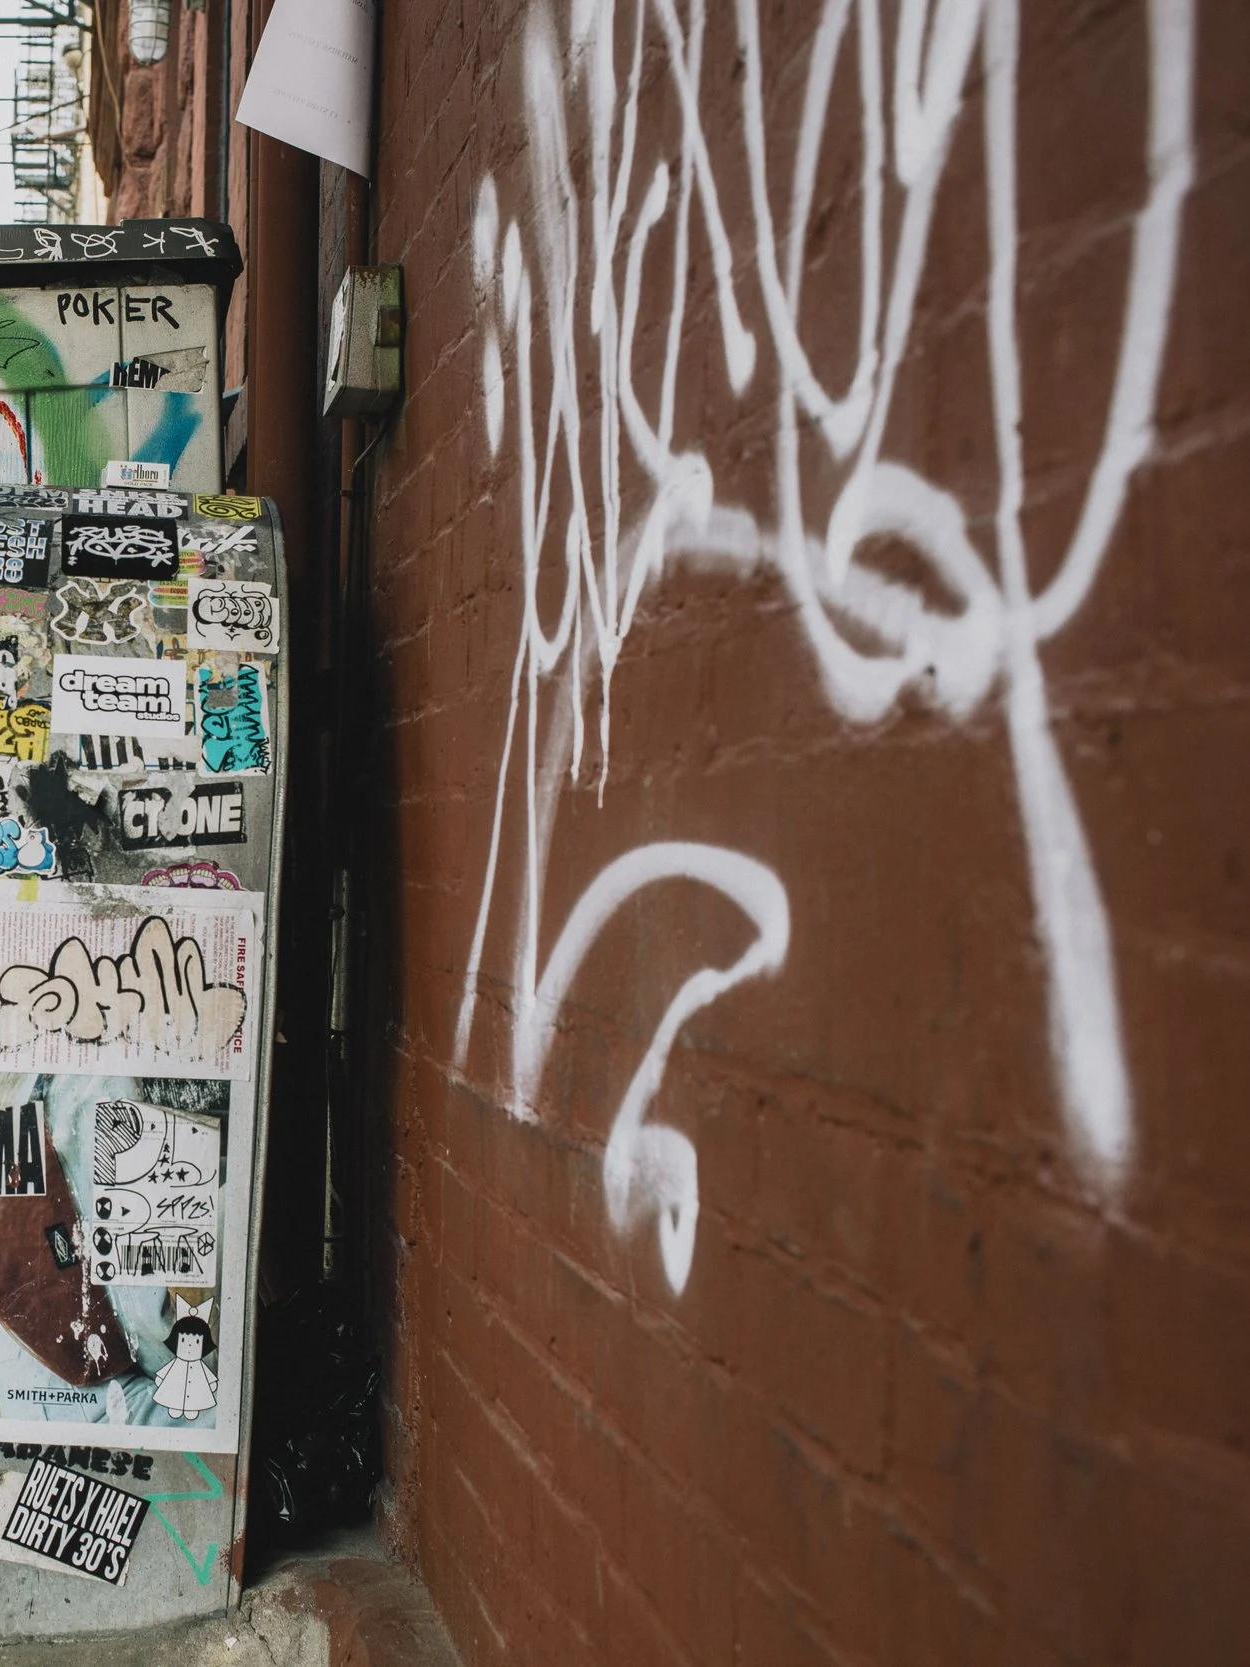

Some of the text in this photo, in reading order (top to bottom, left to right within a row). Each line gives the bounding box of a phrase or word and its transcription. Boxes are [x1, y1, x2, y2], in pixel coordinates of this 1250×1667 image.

[57, 292, 179, 329] POKER
[120, 464, 159, 480] rlboro
[79, 499, 182, 518] HEAD
[59, 669, 170, 695] dream
[81, 691, 171, 712] team
[136, 712, 180, 722] studios
[237, 937, 246, 963] FIRE
[7, 1389, 98, 1404] SMITH+PARKA
[19, 1460, 142, 1547] RUETS X HAEL
[6, 1505, 126, 1579] DIRTY 30'S
